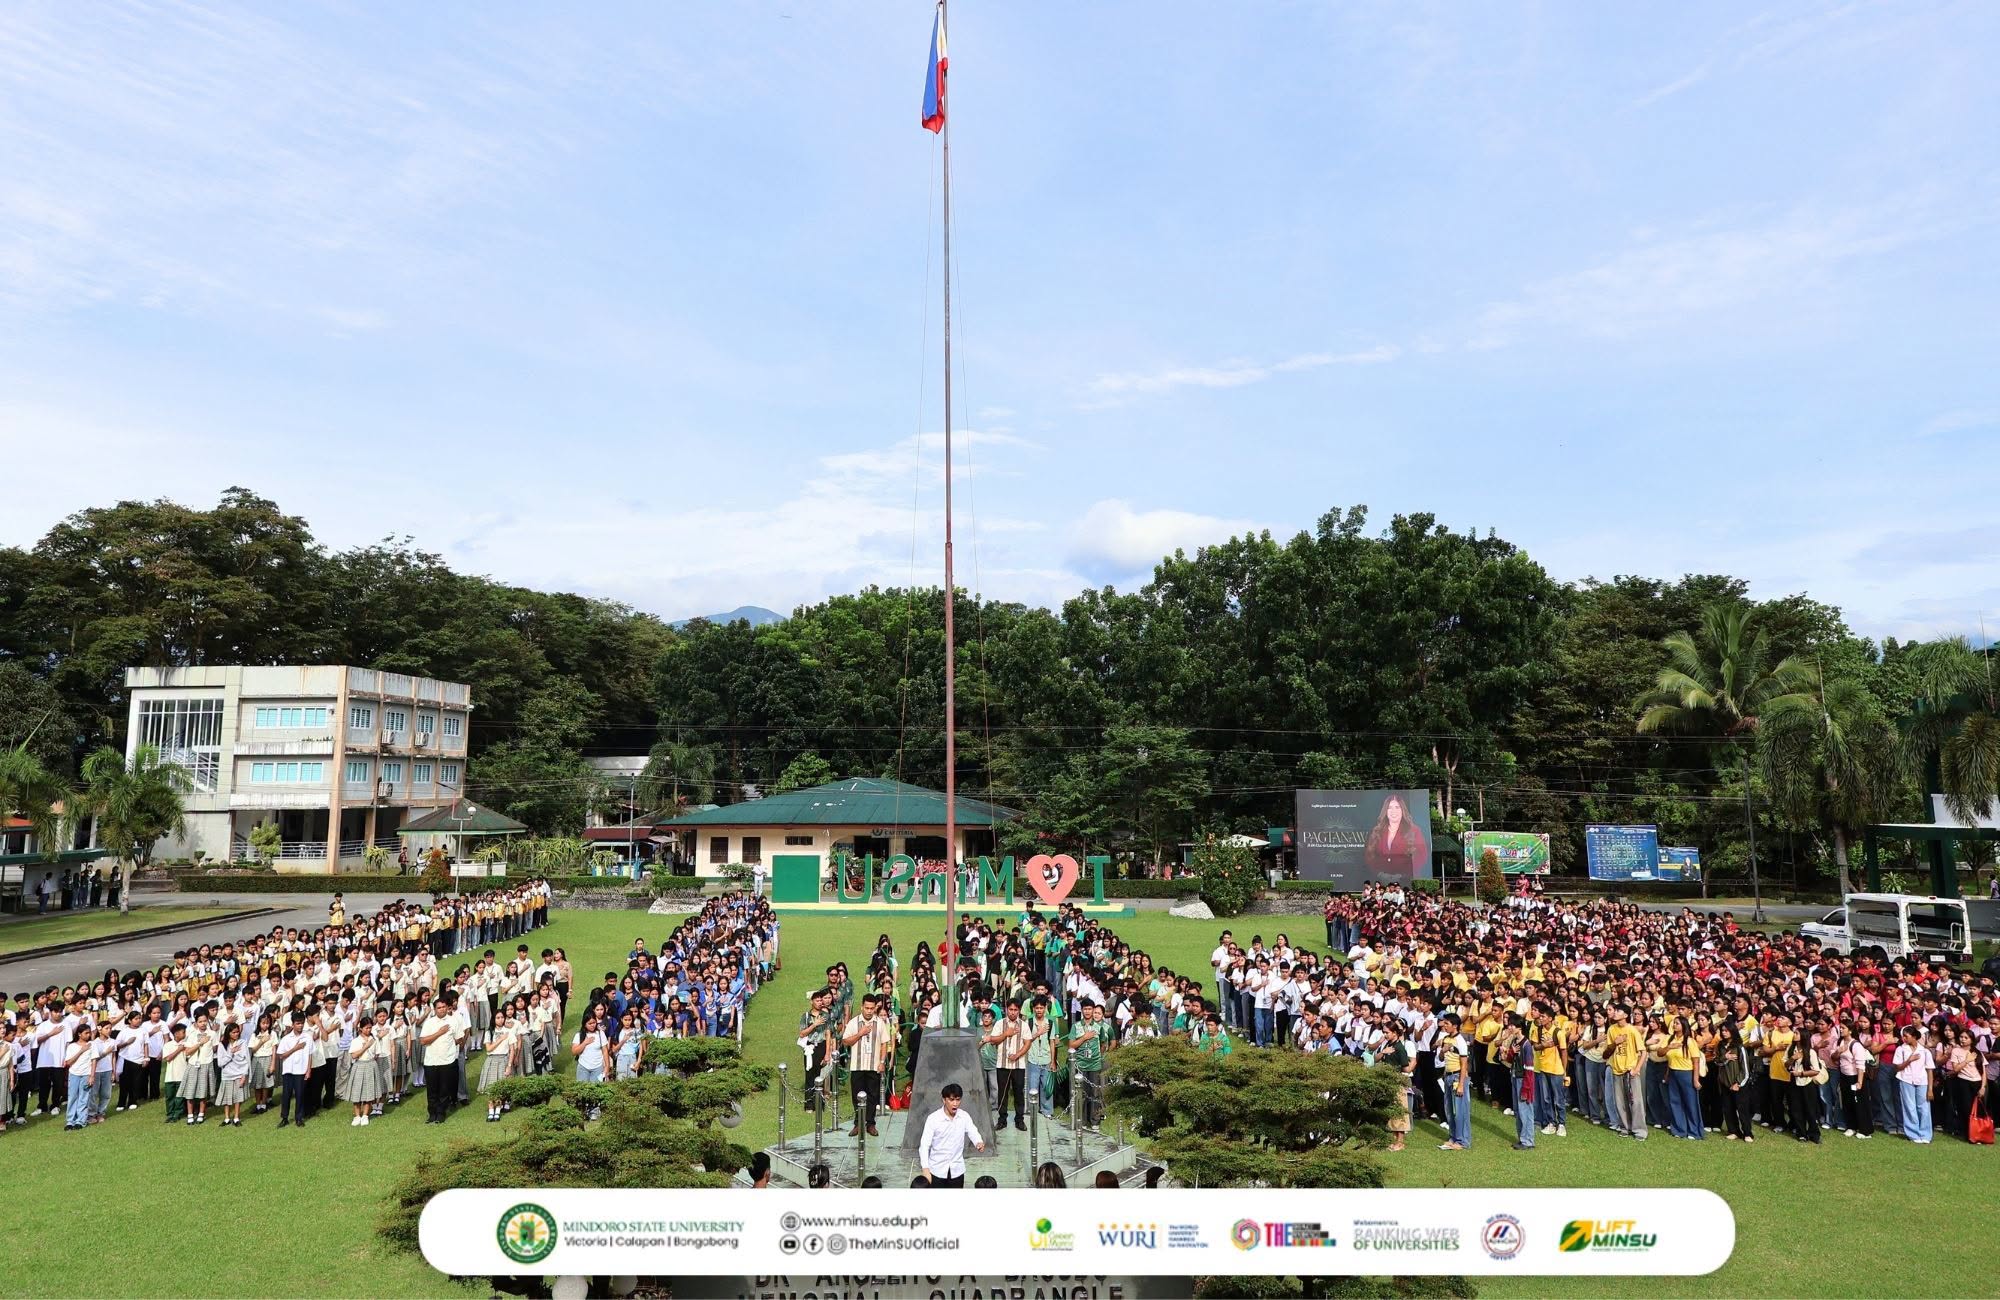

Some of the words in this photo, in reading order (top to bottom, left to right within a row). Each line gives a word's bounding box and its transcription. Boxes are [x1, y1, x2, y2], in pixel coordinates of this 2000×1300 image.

[1303, 831, 1368, 843] PAGTANAW
[1887, 945, 1902, 955] 1922
[737, 1289, 879, 1300] ORIAL
